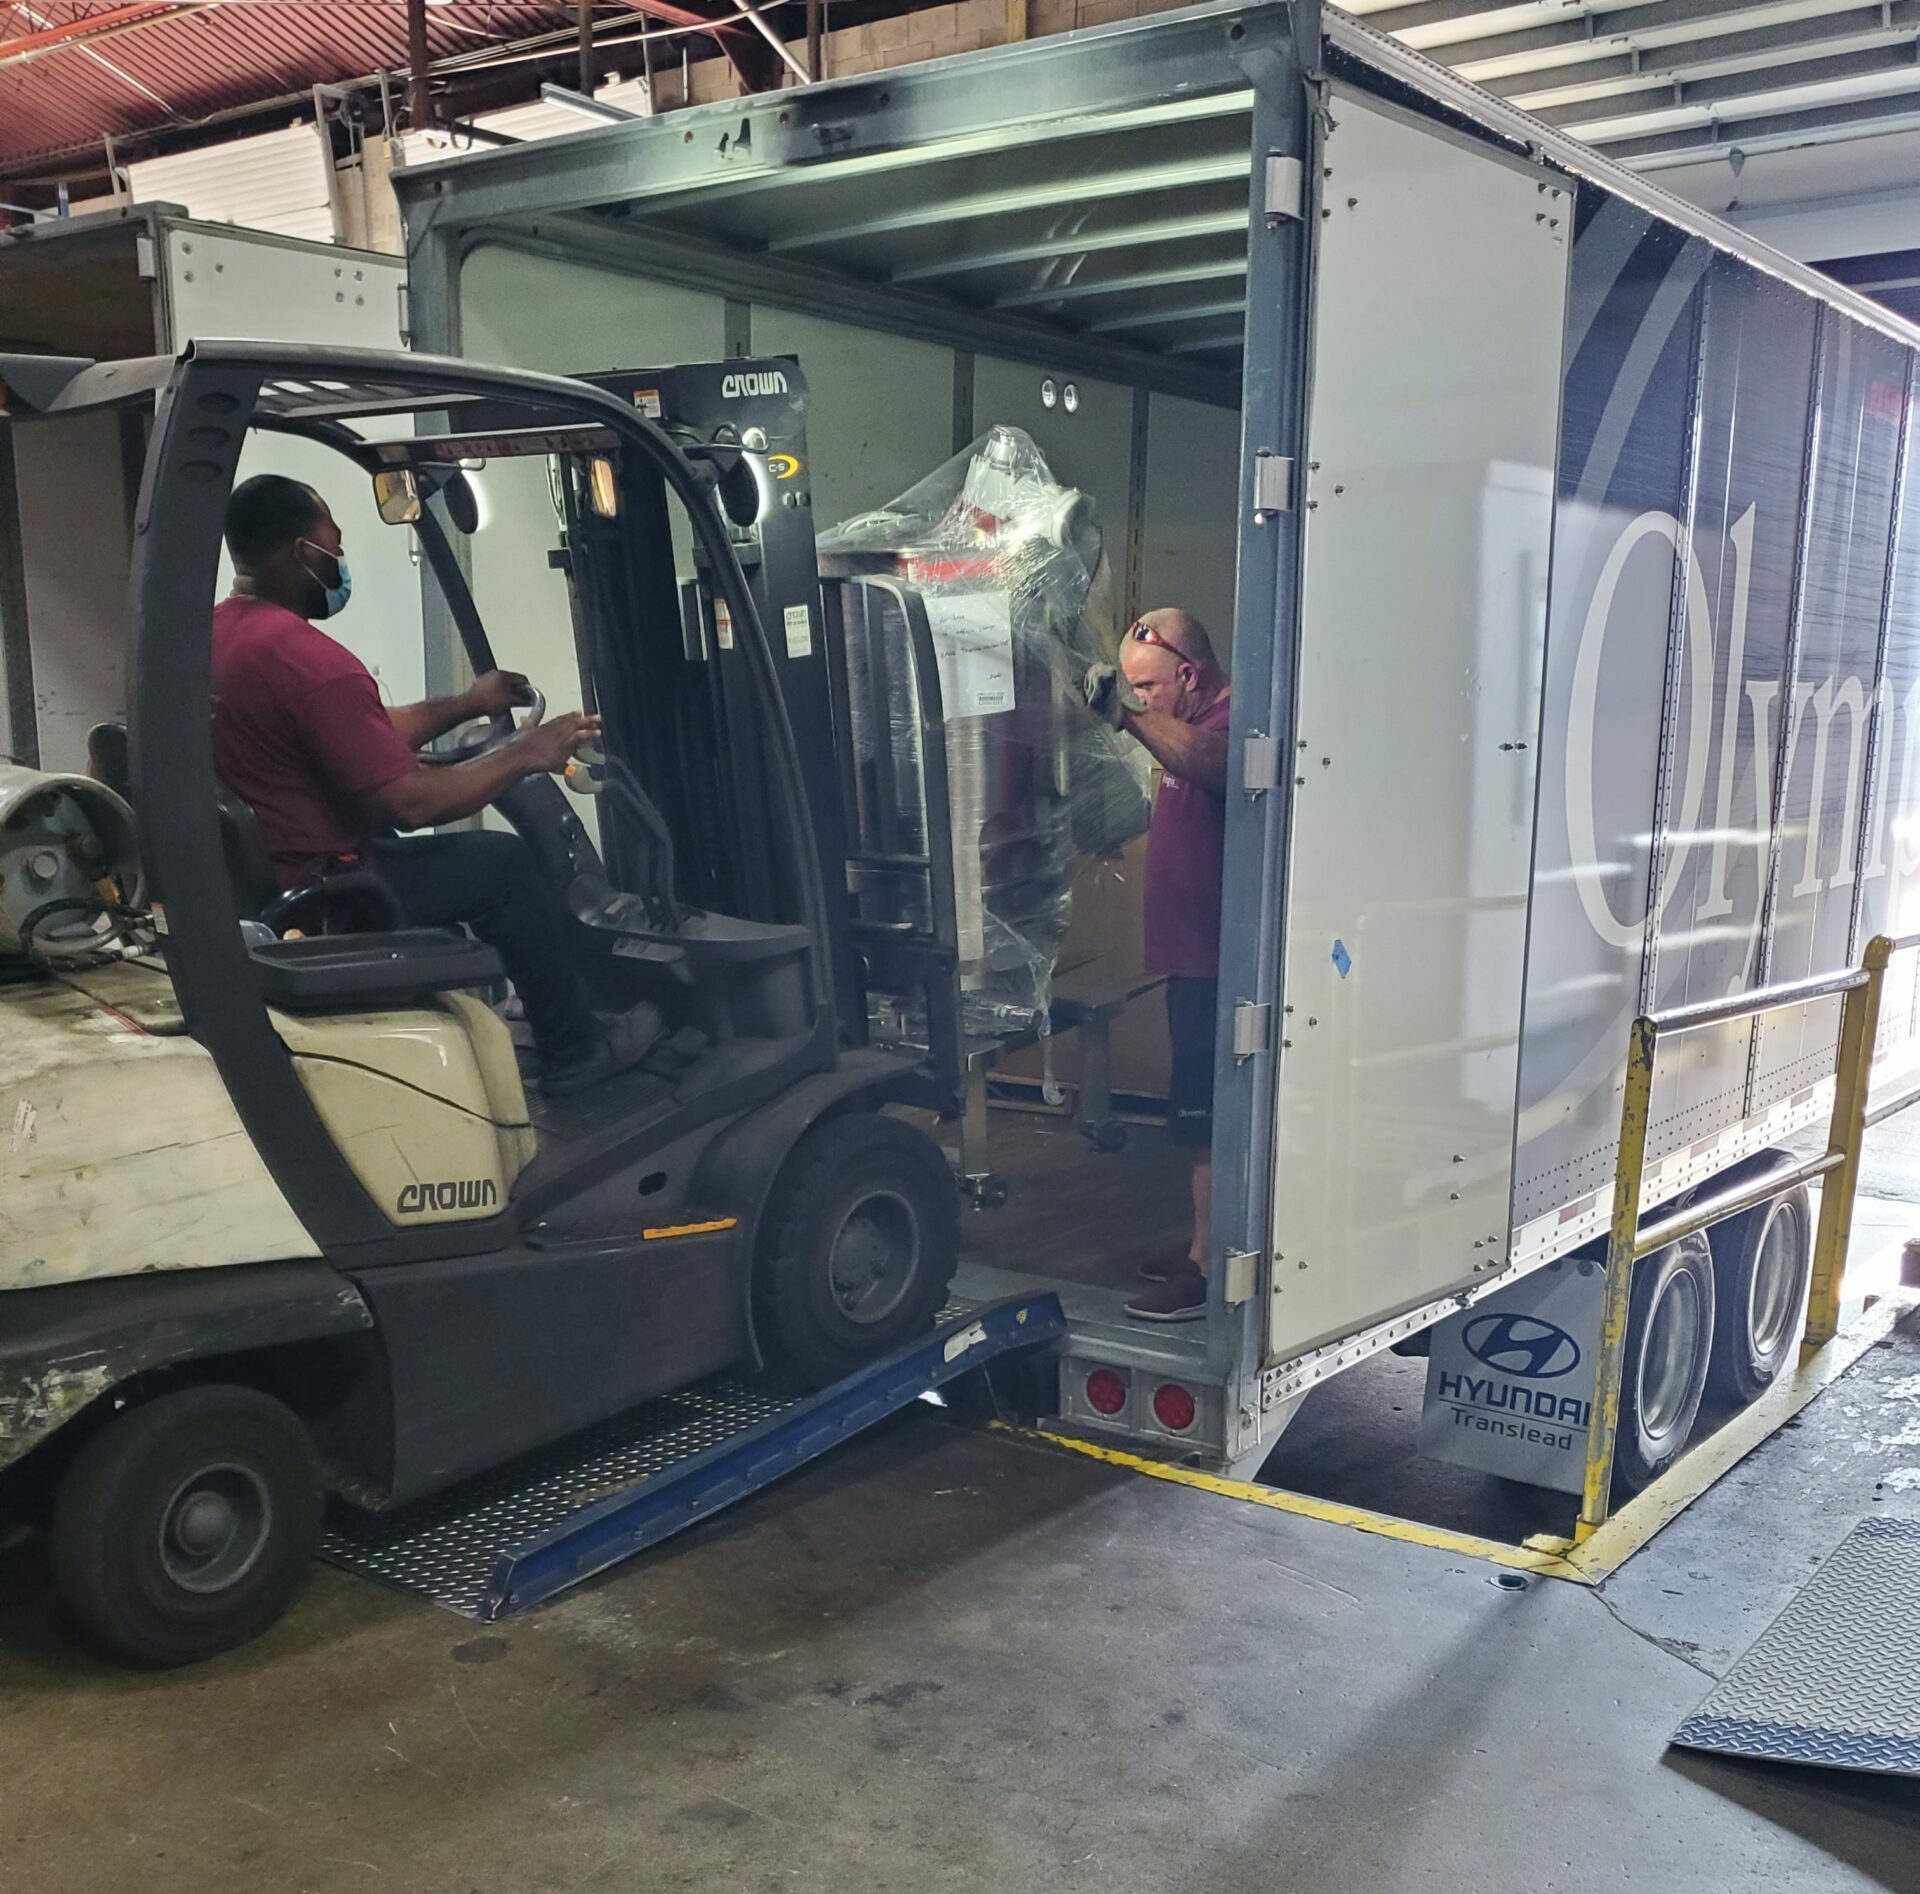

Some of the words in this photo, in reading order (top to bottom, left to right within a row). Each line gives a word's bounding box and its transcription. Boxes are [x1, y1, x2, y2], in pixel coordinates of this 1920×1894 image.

[722, 371, 787, 398] CROWN
[397, 1179, 496, 1213] CROWN
[1438, 1371, 1591, 1426] HYUNDAI
[1452, 1407, 1572, 1450] Translead
